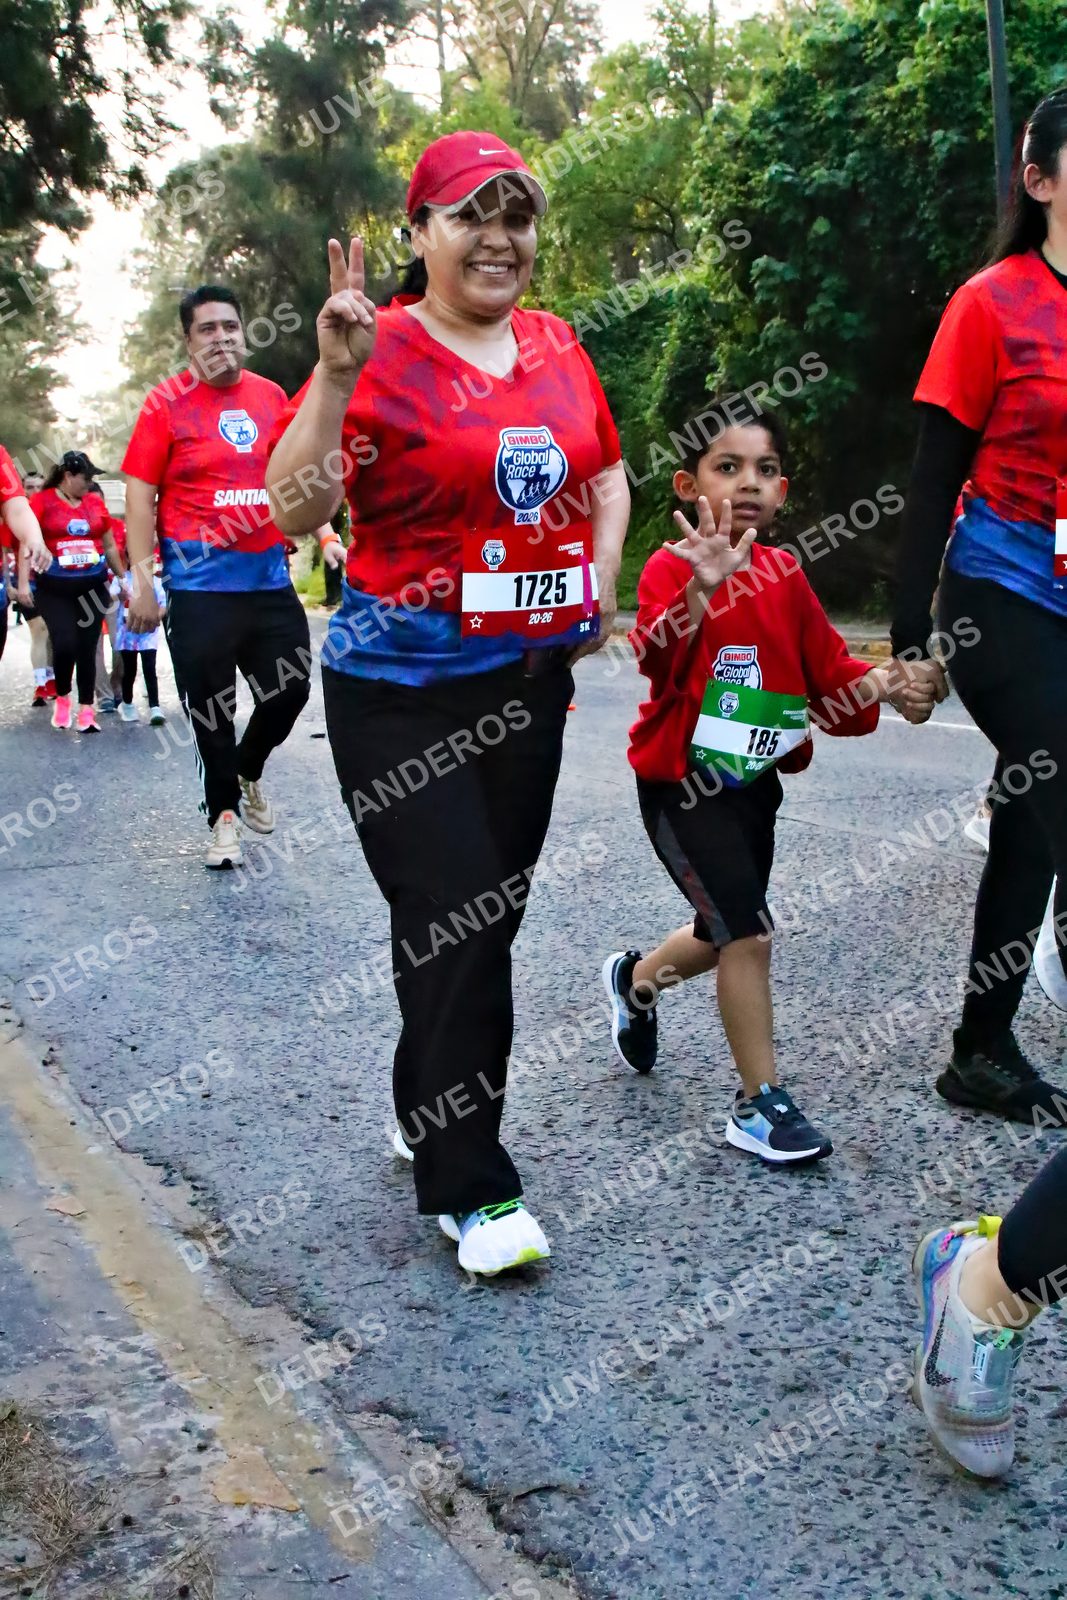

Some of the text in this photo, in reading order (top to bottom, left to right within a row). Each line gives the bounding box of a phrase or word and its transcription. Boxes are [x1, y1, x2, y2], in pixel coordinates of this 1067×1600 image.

[507, 435, 547, 446] BIMBO
[513, 450, 549, 465] Global
[506, 465, 536, 479] Race
[213, 489, 270, 507] SANTIA
[517, 512, 539, 523] 2026
[514, 572, 567, 608] 1725
[724, 652, 752, 662] BIMBO
[723, 666, 751, 679] Global
[746, 728, 783, 757] 185
